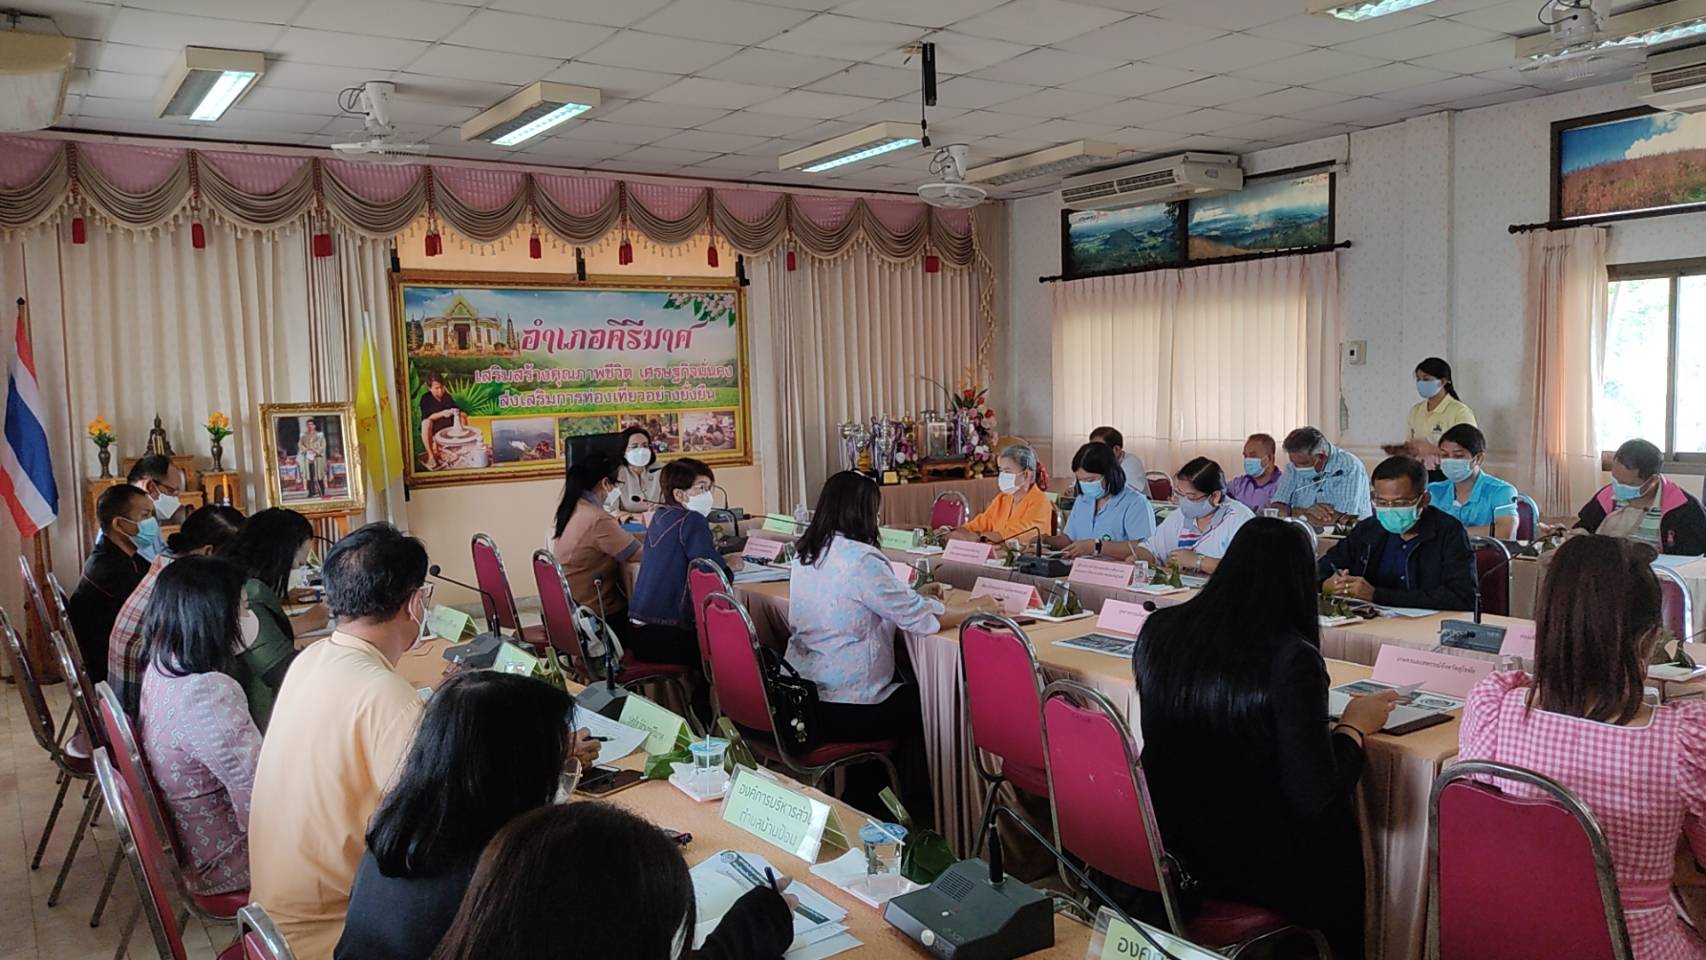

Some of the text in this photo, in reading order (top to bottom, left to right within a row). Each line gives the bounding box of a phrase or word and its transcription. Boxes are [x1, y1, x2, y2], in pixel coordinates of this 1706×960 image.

[474, 358, 733, 388] เสริมสร้างคุณภาพชีวิต เศรษฐกิจมั่นคง
[498, 381, 715, 408] ส่งเสริมการท่องเที่ยวอย่างยั่งยืน
